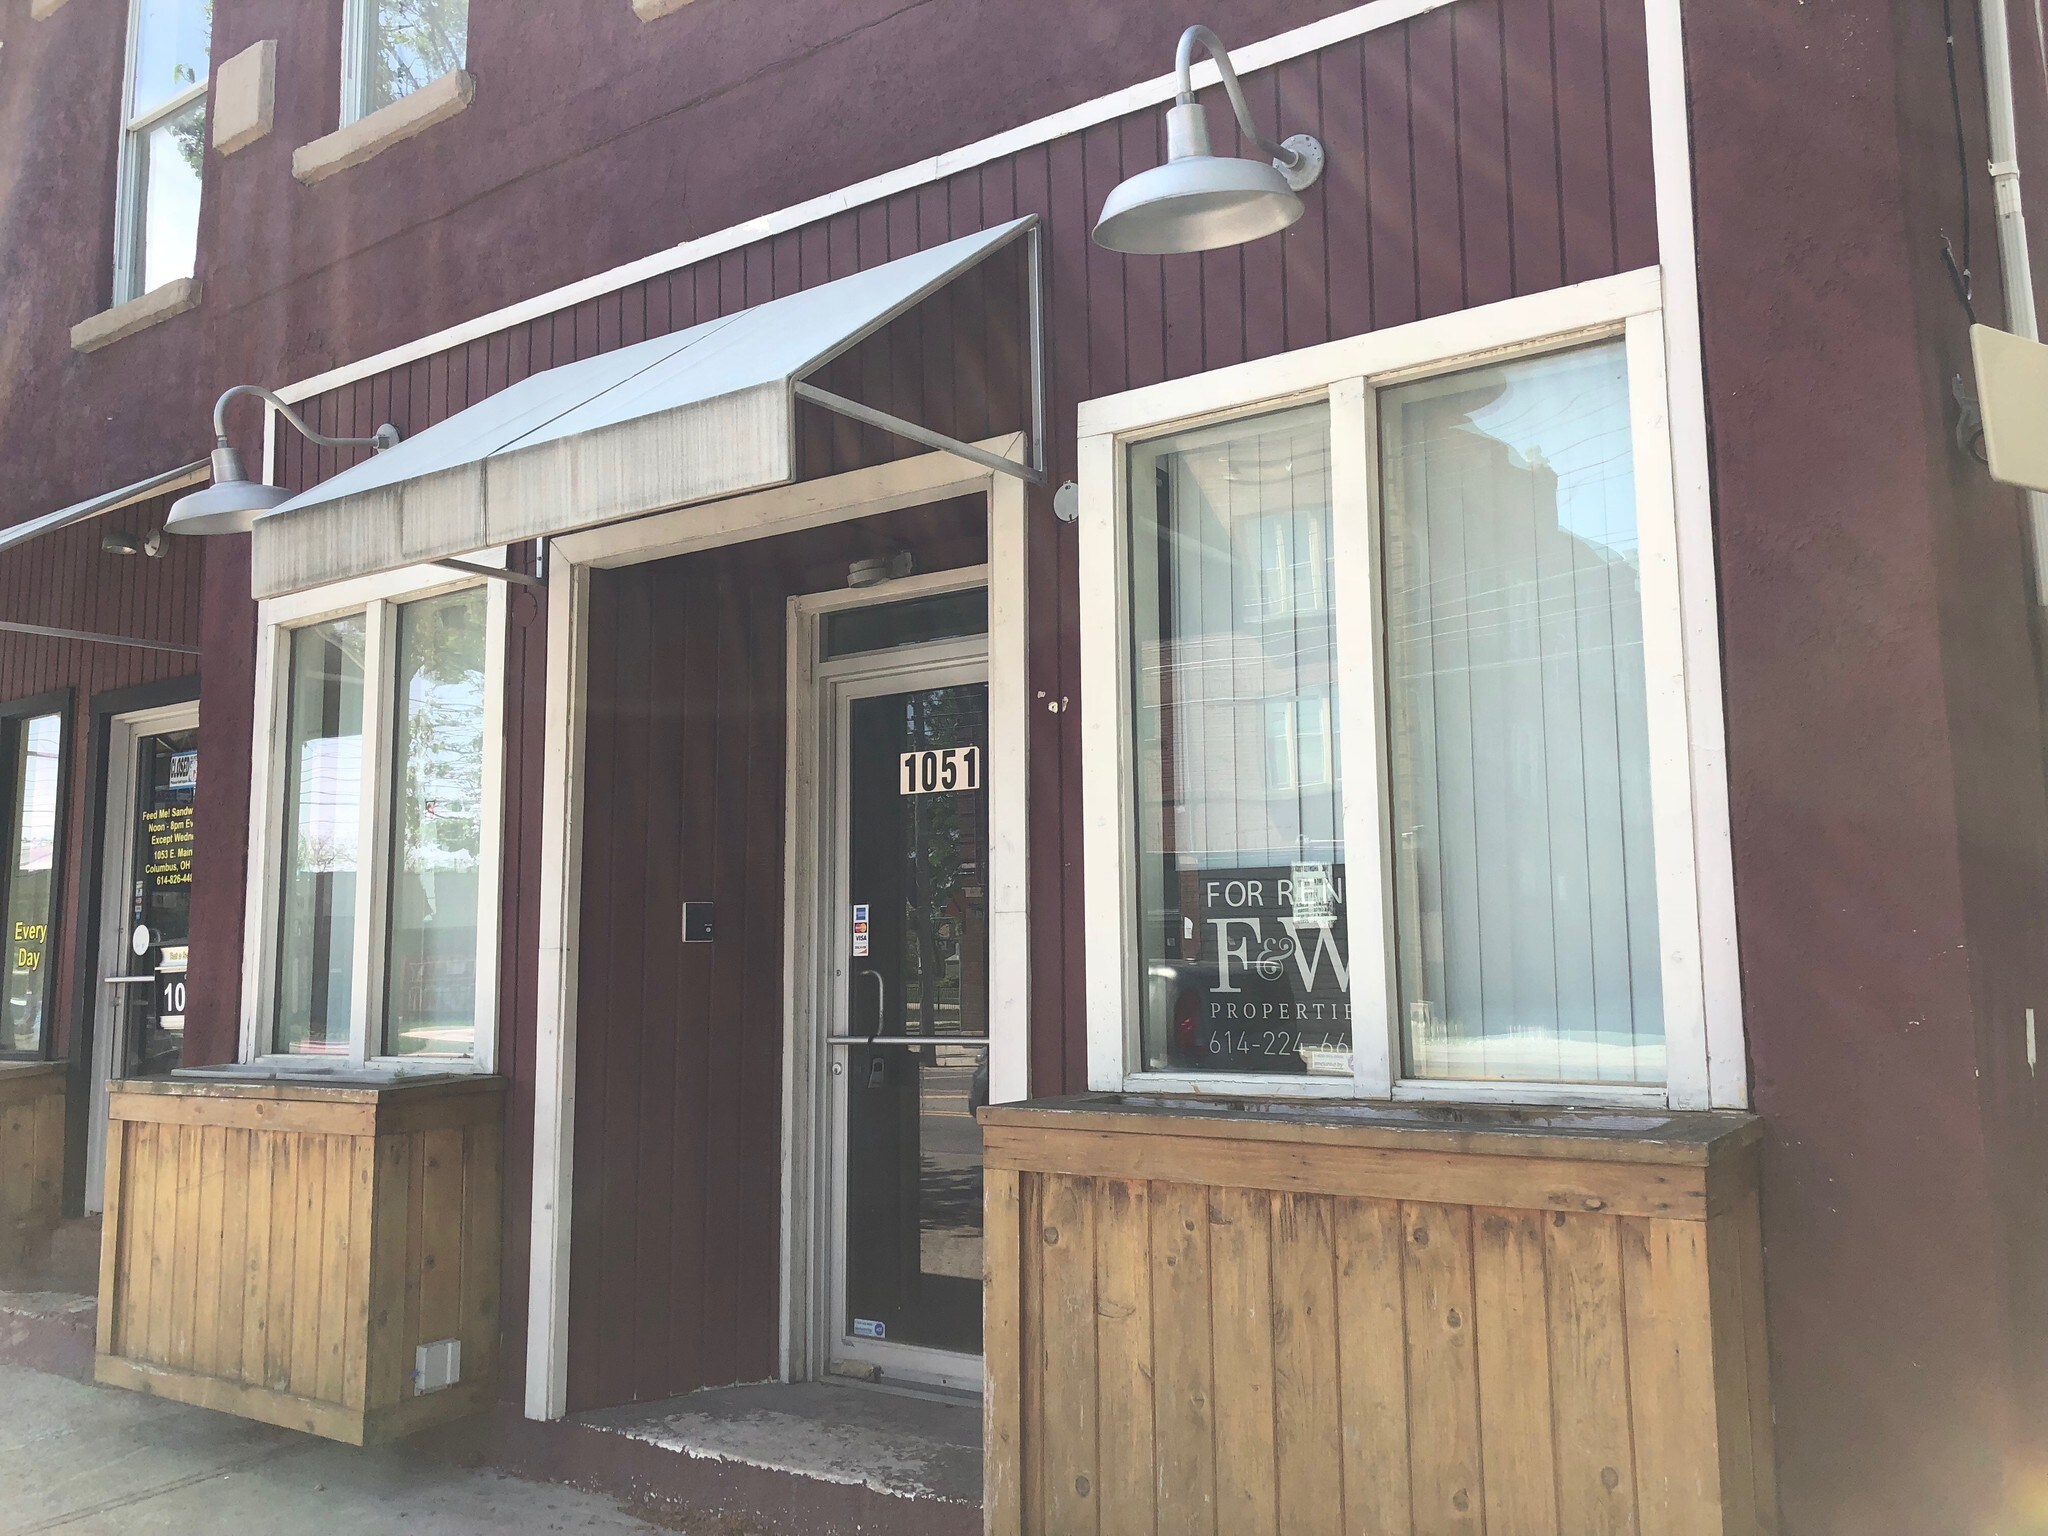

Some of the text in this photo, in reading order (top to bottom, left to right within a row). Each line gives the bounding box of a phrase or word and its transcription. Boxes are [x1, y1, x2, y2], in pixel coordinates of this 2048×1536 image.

[171, 757, 190, 778] CLOSED
[904, 748, 976, 793] 1051
[142, 810, 158, 820] Feed
[159, 808, 170, 818] Me!
[148, 823, 165, 832] Noon
[170, 821, 184, 832] 8pm
[151, 835, 173, 845] Except
[154, 847, 193, 860] 1053 E. Main
[145, 860, 191, 874] Columbus, OH
[1206, 880, 1264, 908] FOR
[1277, 876, 1343, 906] REN
[15, 922, 47, 943] Every
[18, 948, 40, 971] Day
[1206, 915, 1351, 993] F&W
[164, 982, 186, 1012] 10
[1209, 1030, 1349, 1056] 614-224-66
